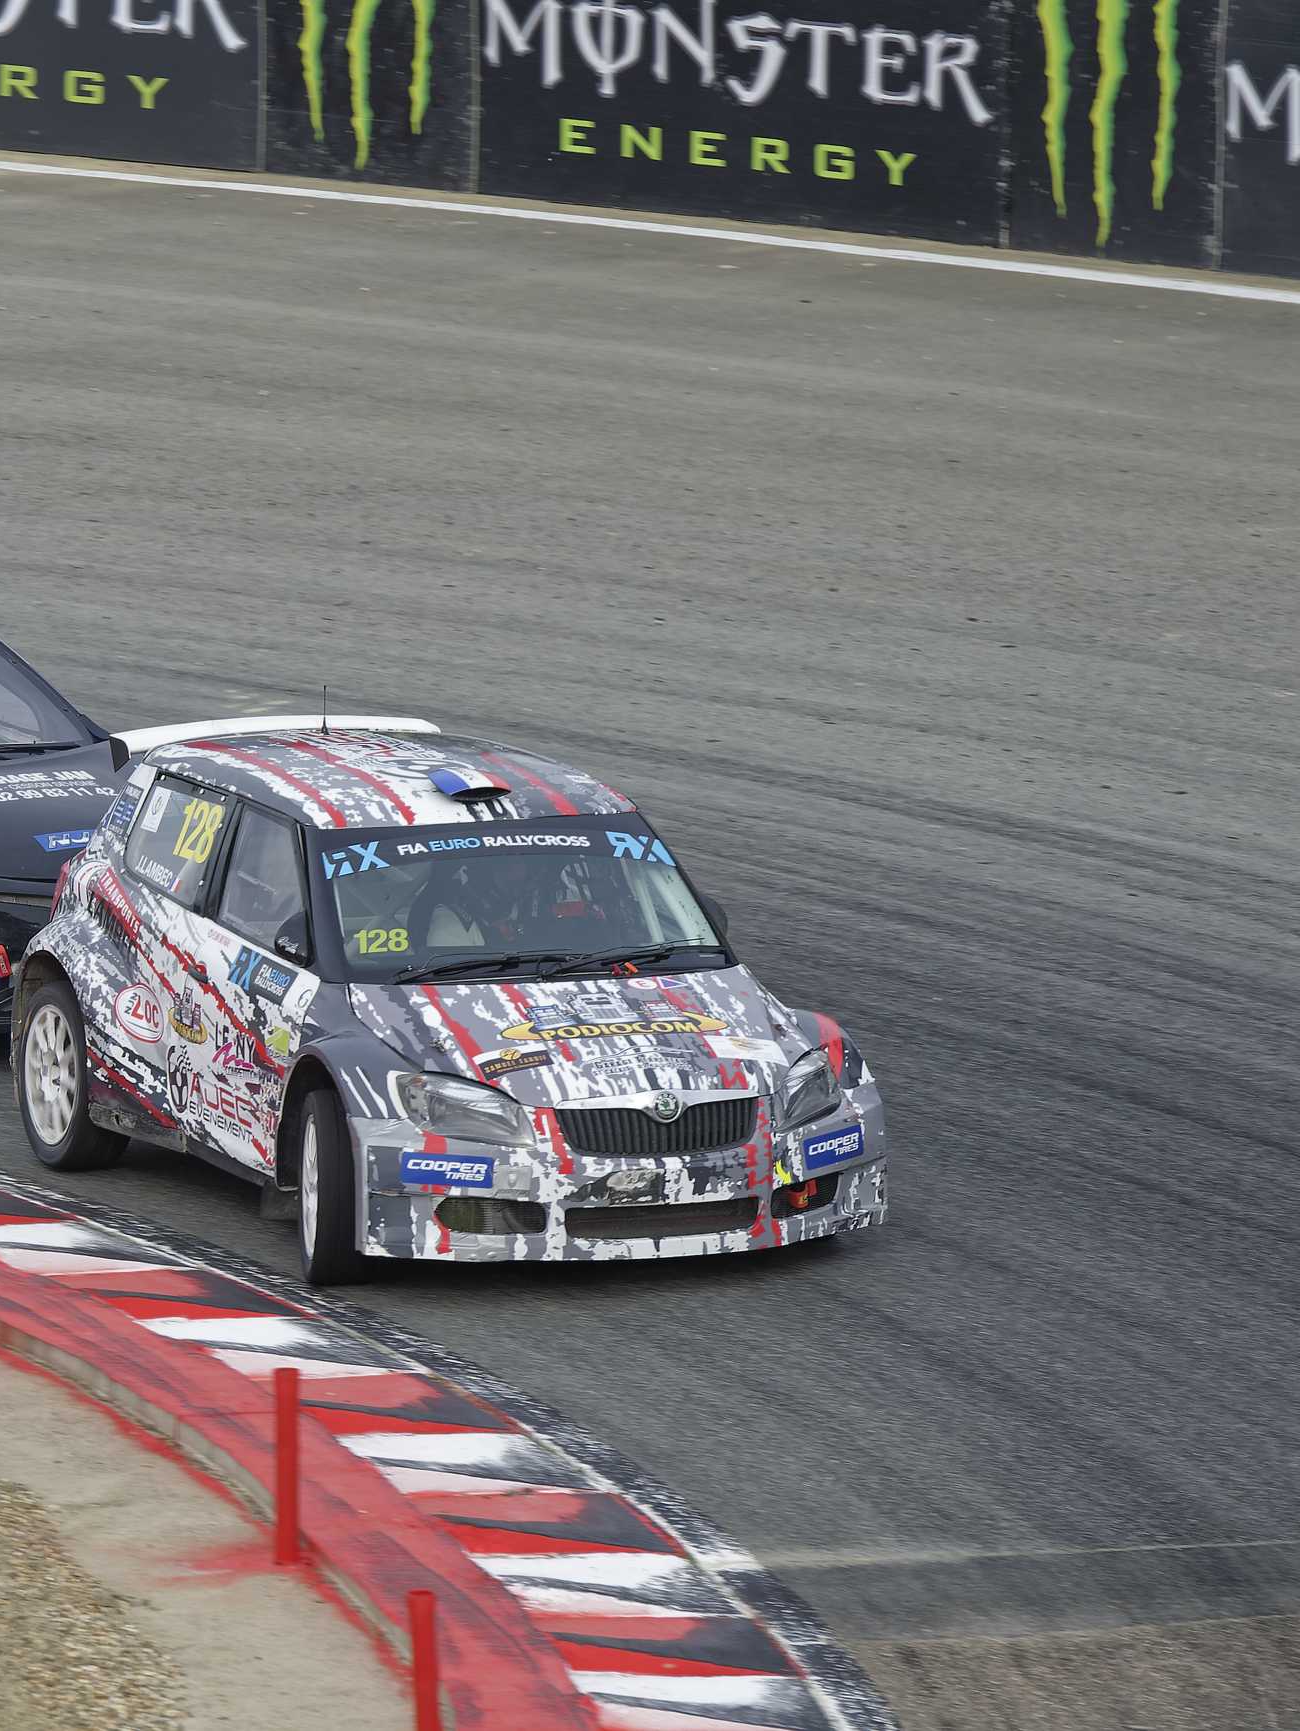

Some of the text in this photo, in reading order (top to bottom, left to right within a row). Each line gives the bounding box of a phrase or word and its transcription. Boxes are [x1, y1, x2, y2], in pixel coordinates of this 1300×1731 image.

[559, 117, 918, 187] ENERGY
[52, 770, 96, 780] JAN
[16, 789, 44, 799] 99
[68, 786, 93, 796] 11
[172, 798, 224, 864] 128
[397, 844, 428, 856] FIA
[428, 837, 481, 852] EURO
[482, 834, 591, 847] RALLYCROSS
[101, 871, 140, 934] TRANSPORTS
[353, 926, 409, 955] 128
[255, 974, 284, 997] RALLYCROSS
[537, 1021, 701, 1041] PODIOCOM
[808, 1132, 859, 1156] COOPER
[835, 1143, 859, 1156] TIRES
[407, 1159, 488, 1174] COOPER
[444, 1172, 485, 1181] TIRES
